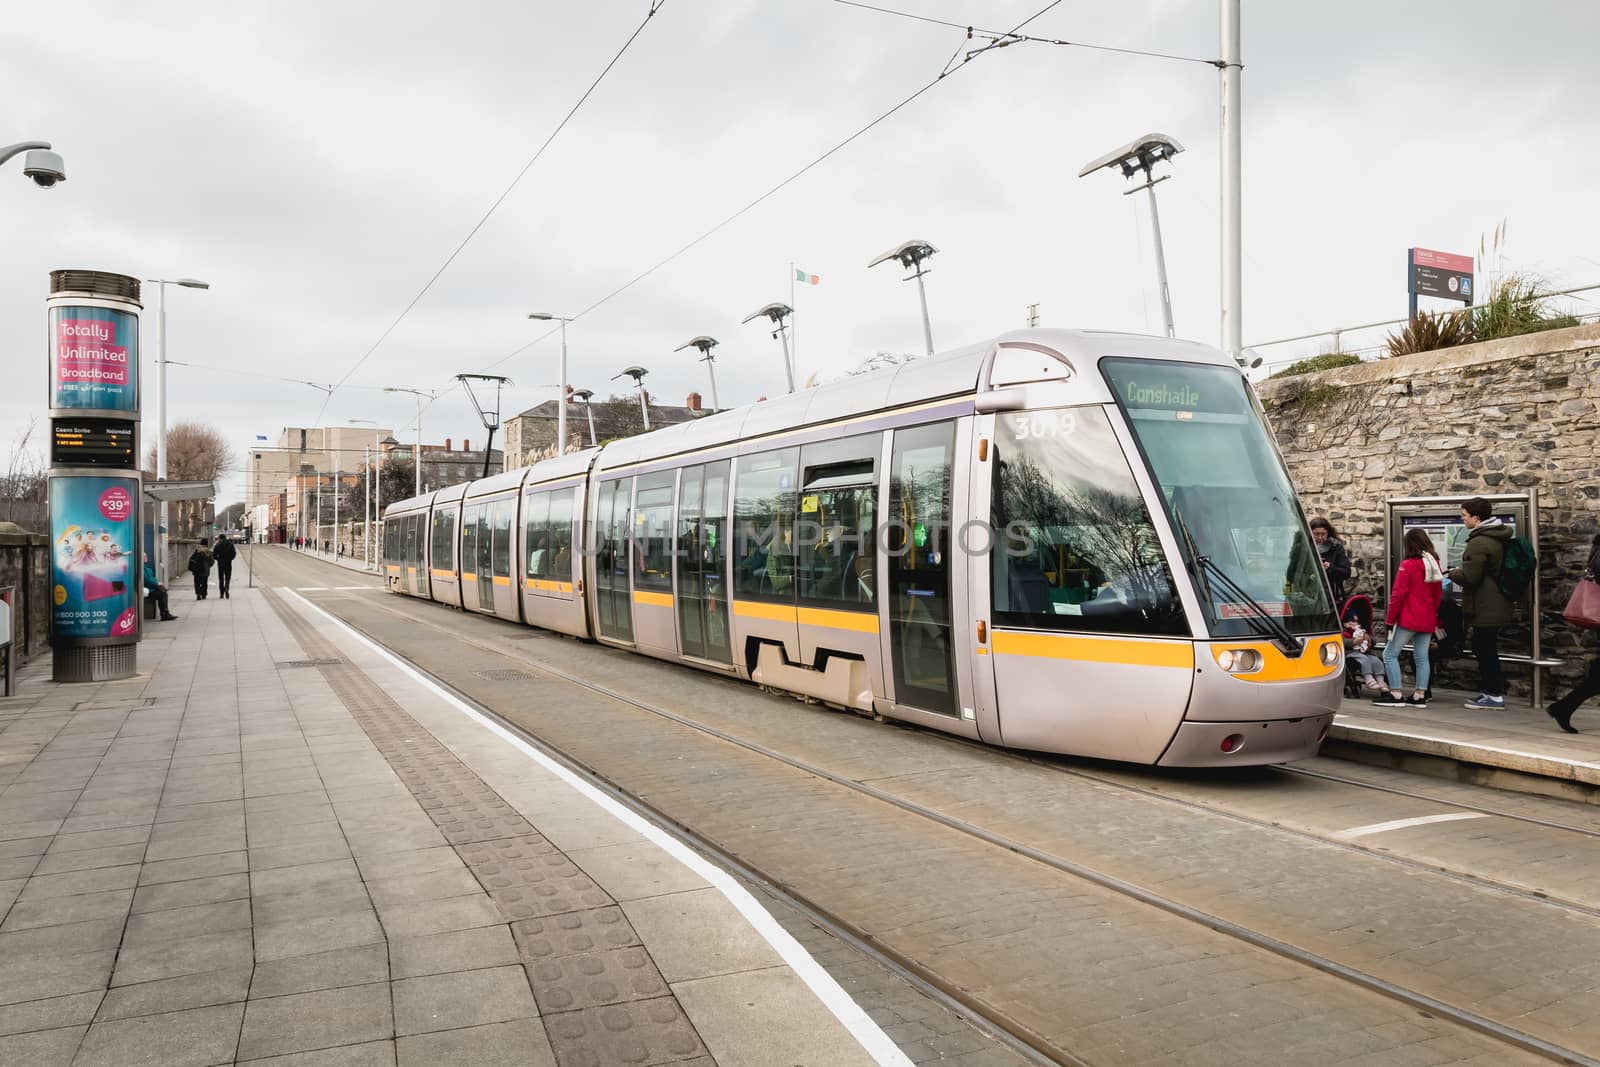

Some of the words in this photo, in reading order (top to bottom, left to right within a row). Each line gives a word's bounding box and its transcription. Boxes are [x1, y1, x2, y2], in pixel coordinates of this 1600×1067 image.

[61, 323, 109, 341] Totally
[60, 346, 126, 362] Unlimited
[61, 367, 124, 381] Broadband
[1127, 381, 1199, 406] Conghaile
[120, 613, 135, 629] eir
